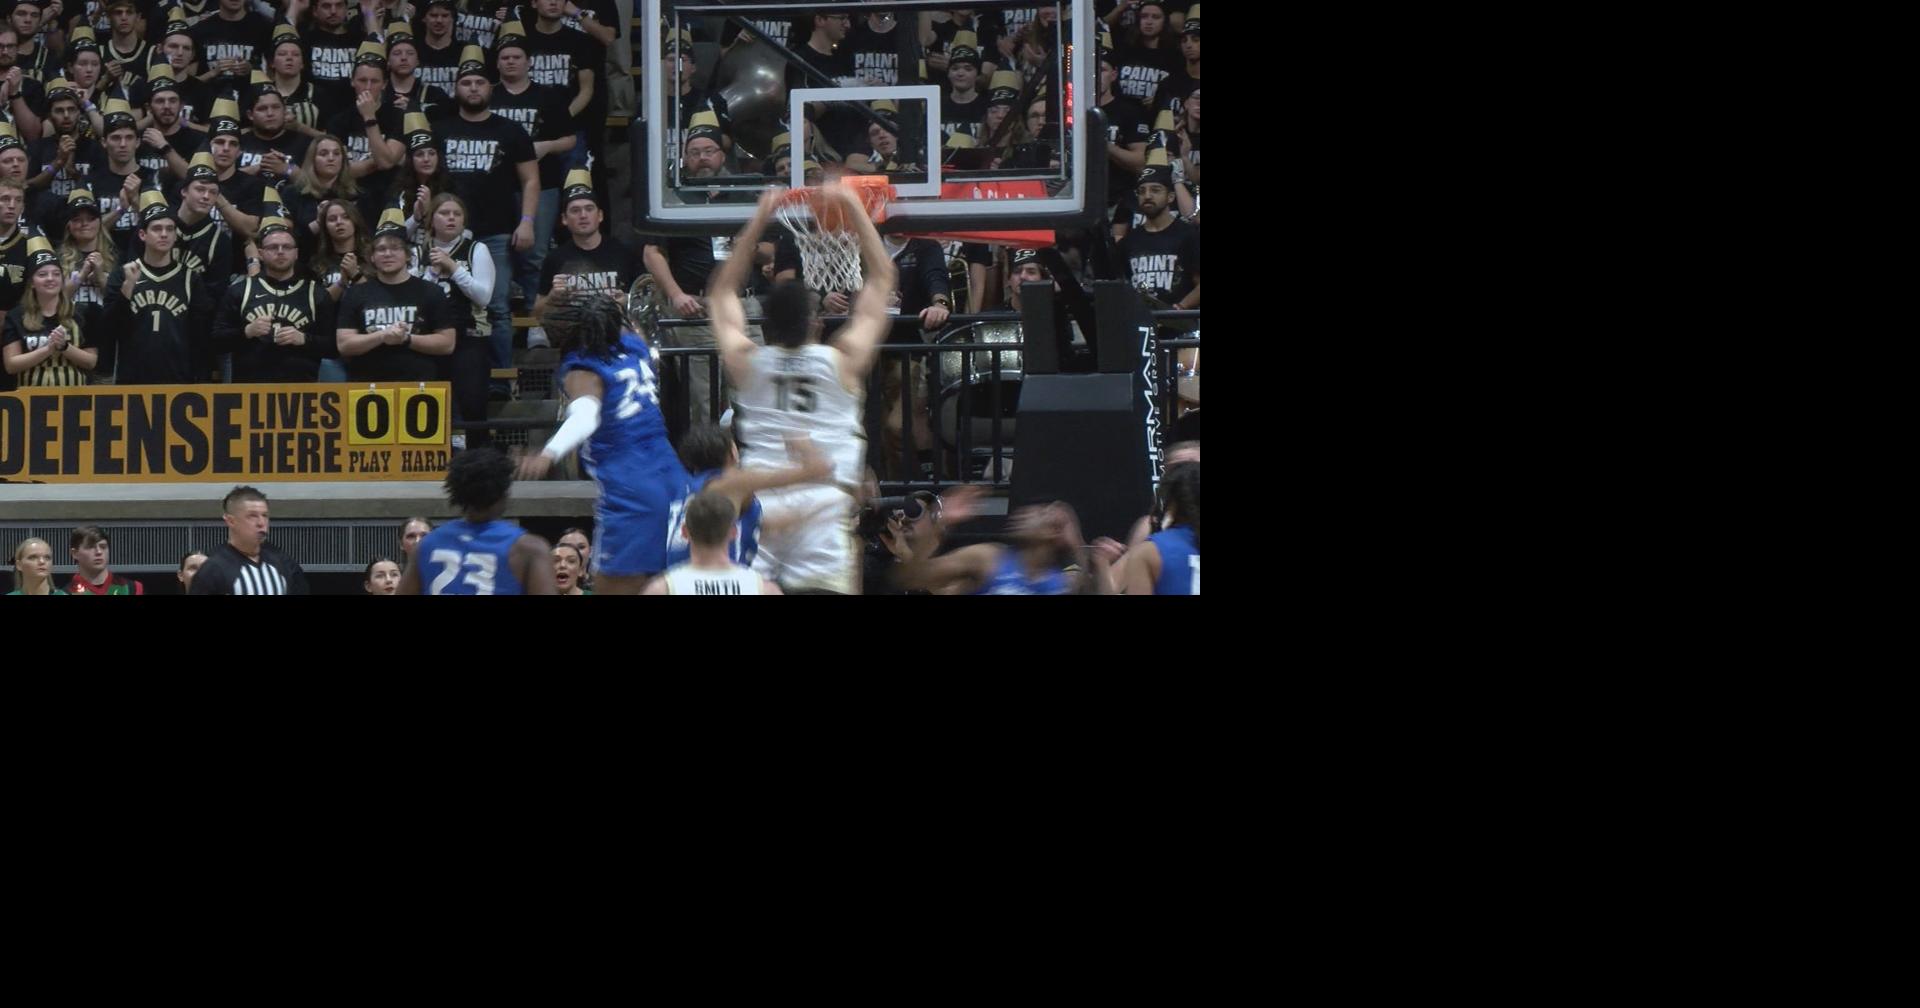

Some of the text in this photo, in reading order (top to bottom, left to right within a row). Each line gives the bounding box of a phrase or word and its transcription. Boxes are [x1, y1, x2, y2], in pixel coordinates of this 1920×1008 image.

[206, 45, 253, 60] PAINT
[446, 139, 499, 155] PAINT
[446, 154, 494, 171] CREW
[1131, 254, 1178, 272] PAINT
[130, 290, 187, 316] PURDUE
[152, 311, 161, 332] 1
[365, 306, 417, 325] PAINT
[614, 359, 659, 419] 24
[249, 391, 341, 430] LIVES
[0, 391, 243, 476] DEFENSE
[249, 431, 342, 474] HERE
[349, 450, 447, 473] PLAY HARD
[429, 549, 498, 595] 23
